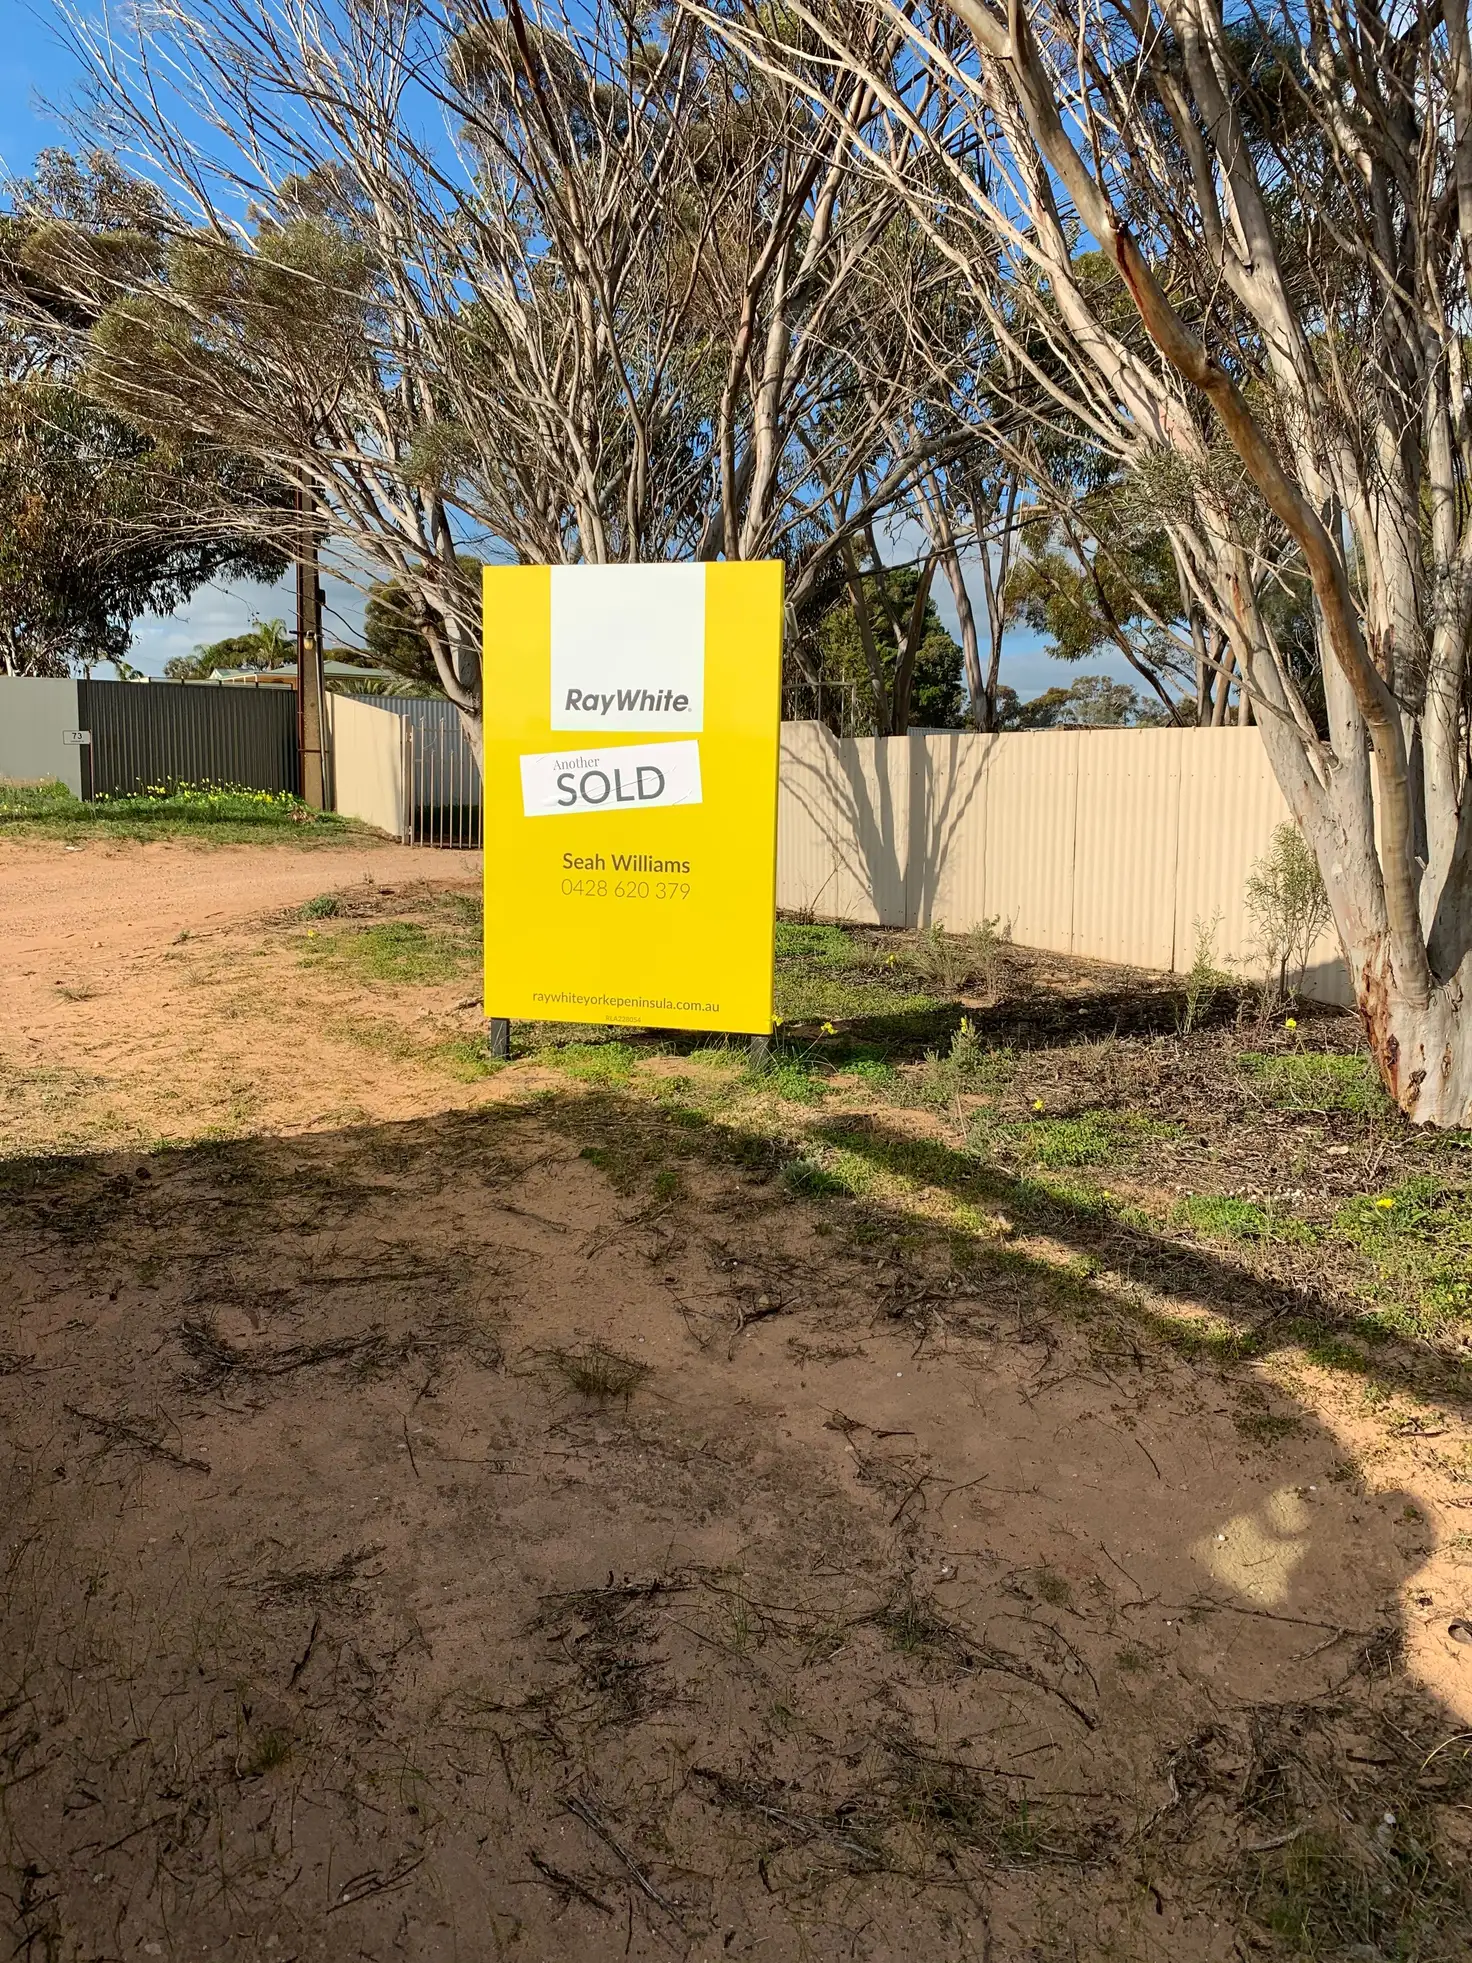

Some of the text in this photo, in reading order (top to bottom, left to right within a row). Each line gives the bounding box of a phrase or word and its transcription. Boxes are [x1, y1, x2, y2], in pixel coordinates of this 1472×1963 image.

[565, 688, 689, 715] RayWhite
[553, 756, 600, 771] Another
[556, 766, 666, 807] SOLD
[562, 852, 691, 874] Seah Williams
[561, 878, 691, 900] 0428 620 379
[532, 991, 720, 1013] raywhiteyorkepeninsula.com.au
